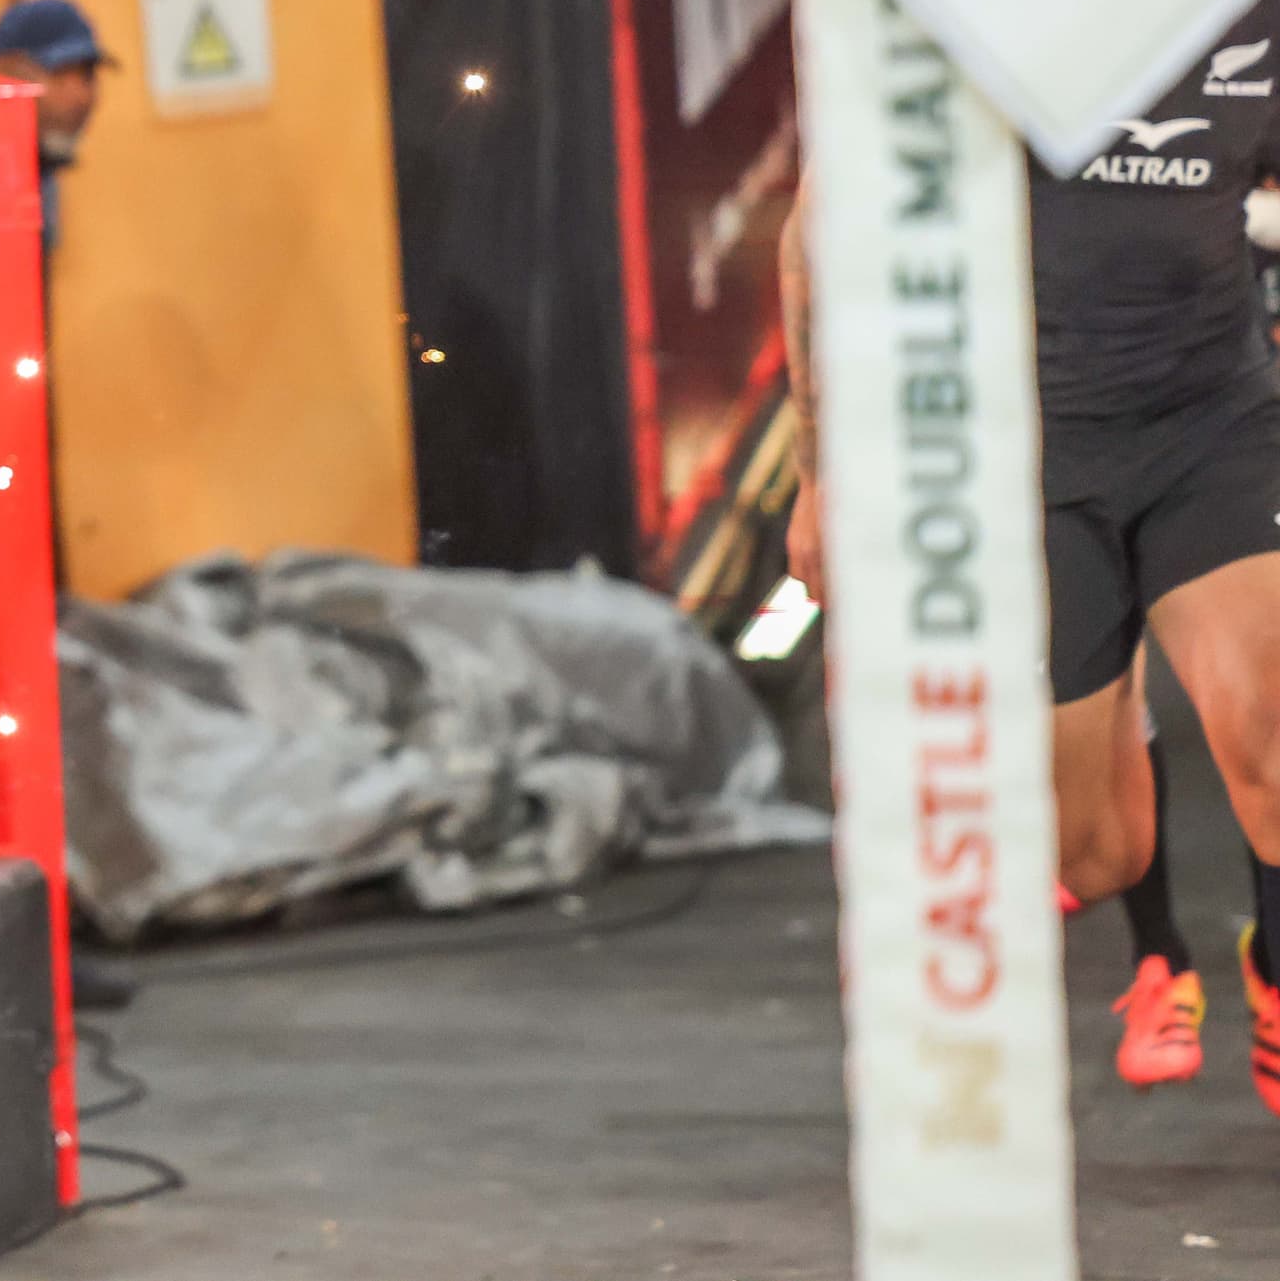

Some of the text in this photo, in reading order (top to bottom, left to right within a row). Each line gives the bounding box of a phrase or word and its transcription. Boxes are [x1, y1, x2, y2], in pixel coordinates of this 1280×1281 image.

[1082, 154, 1211, 187] ALTRAD
[889, 255, 983, 639] DOUBLE
[912, 666, 999, 1011] CASTLE
